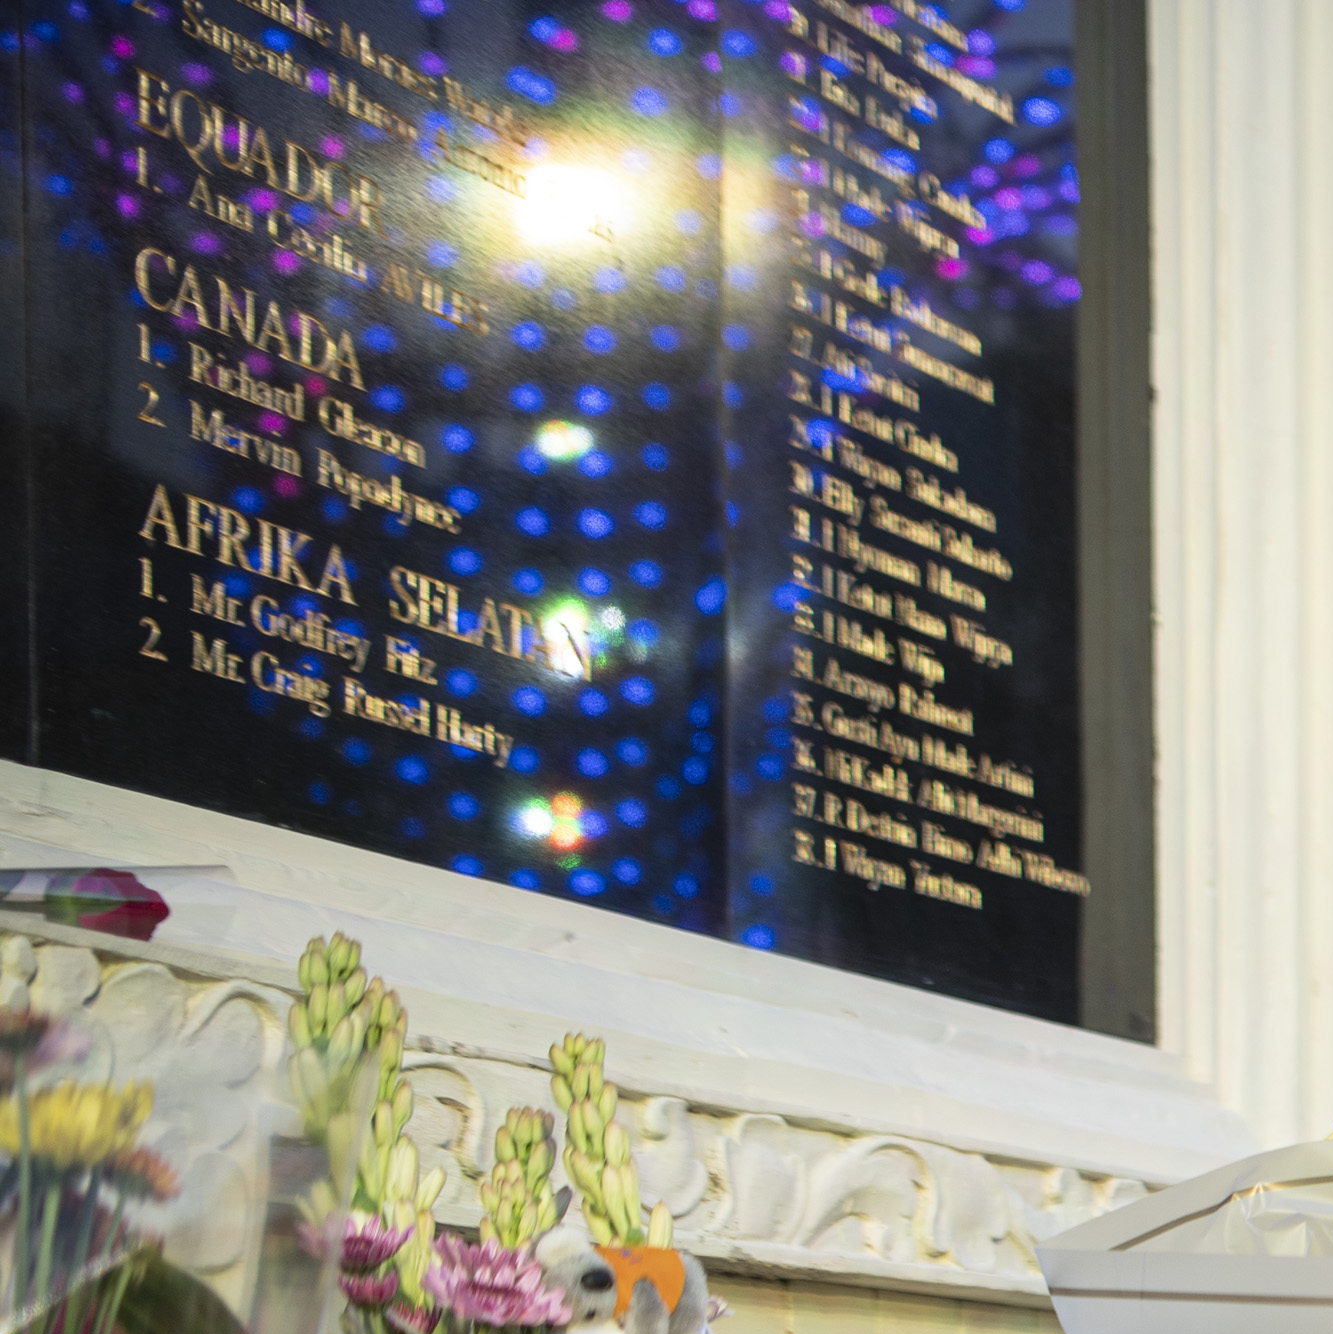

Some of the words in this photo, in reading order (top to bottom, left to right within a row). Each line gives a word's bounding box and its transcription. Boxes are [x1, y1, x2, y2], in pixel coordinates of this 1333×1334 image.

[134, 67, 390, 240] EQUADOR
[188, 174, 254, 233] Ana
[134, 247, 368, 393] CANADA
[188, 341, 305, 423] Richard
[137, 482, 359, 606] AFRIKA
[389, 565, 593, 683] SELATAN
[250, 593, 371, 674] Godfrey
[384, 633, 438, 687] Fitz
[250, 650, 332, 719] Craig
[434, 705, 515, 769] Harty
